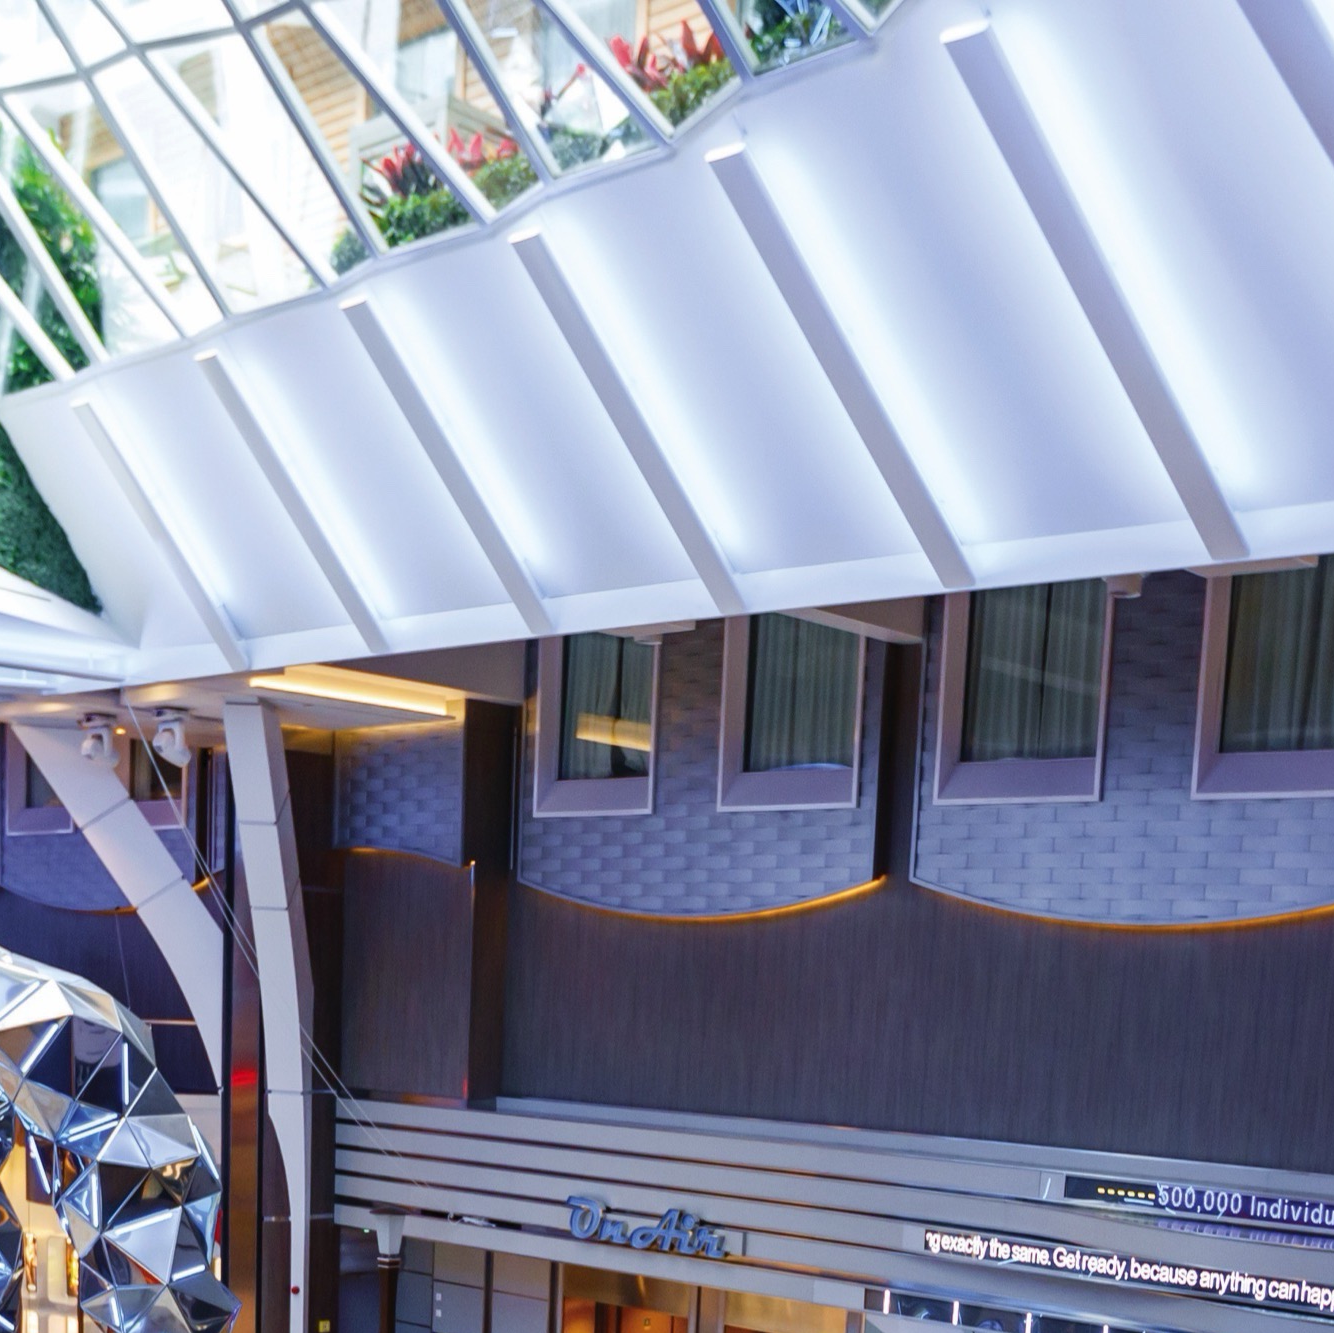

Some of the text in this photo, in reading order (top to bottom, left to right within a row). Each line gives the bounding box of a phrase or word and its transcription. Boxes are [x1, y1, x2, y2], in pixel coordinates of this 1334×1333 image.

[566, 1195, 726, 1258] On Air
[941, 1234, 989, 1260] exactly
[989, 1237, 1011, 1260] the
[1011, 1244, 1051, 1266] same.
[1053, 1247, 1080, 1269] Get
[1081, 1256, 1129, 1280] ready,
[1130, 1256, 1198, 1286] because
[1199, 1270, 1267, 1301] anything
[1268, 1280, 1300, 1300] can
